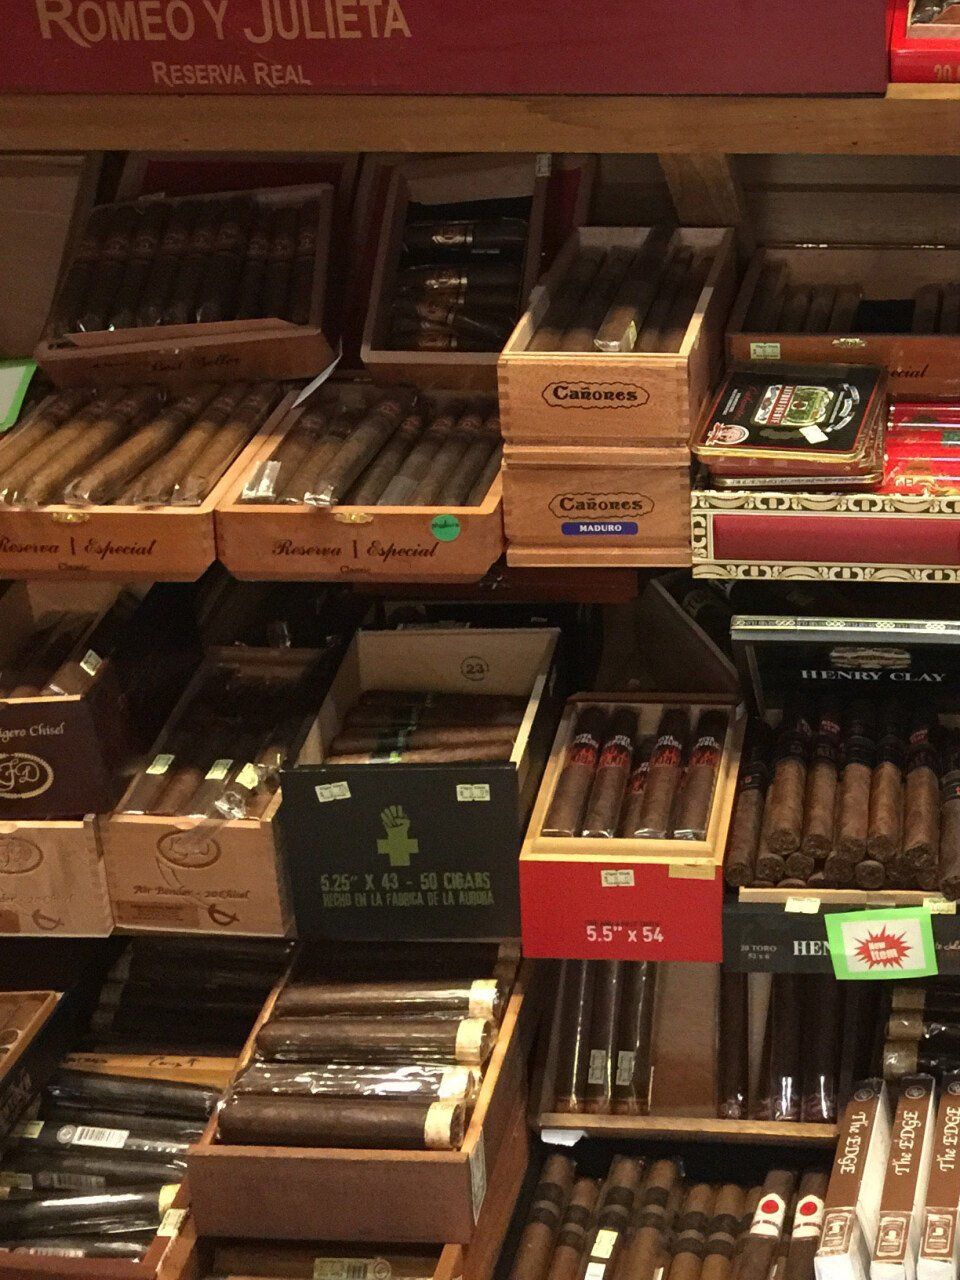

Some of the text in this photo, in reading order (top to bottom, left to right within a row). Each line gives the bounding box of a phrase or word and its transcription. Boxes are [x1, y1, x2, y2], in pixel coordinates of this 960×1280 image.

[202, 0, 229, 40] Y
[152, 61, 311, 88] RESERVA REAL
[553, 385, 639, 402] Cañones
[559, 496, 643, 512] Cañones
[579, 523, 622, 533] MADURO
[84, 537, 157, 558] Especial
[272, 538, 441, 559] Reserva Especial
[466, 663, 484, 674] 23
[800, 669, 945, 683] HENRY CLAY
[29, 722, 65, 736] Chisel
[365, 873, 375, 891] X
[382, 872, 399, 891] 43
[420, 872, 438, 891] 50
[443, 871, 491, 890] CIGARS
[627, 929, 637, 942] x
[642, 926, 664, 943] 54
[793, 940, 832, 956] HEN
[840, 1111, 866, 1175] The EDGE
[892, 1110, 921, 1176] The EDGE
[936, 1146, 957, 1172] The
